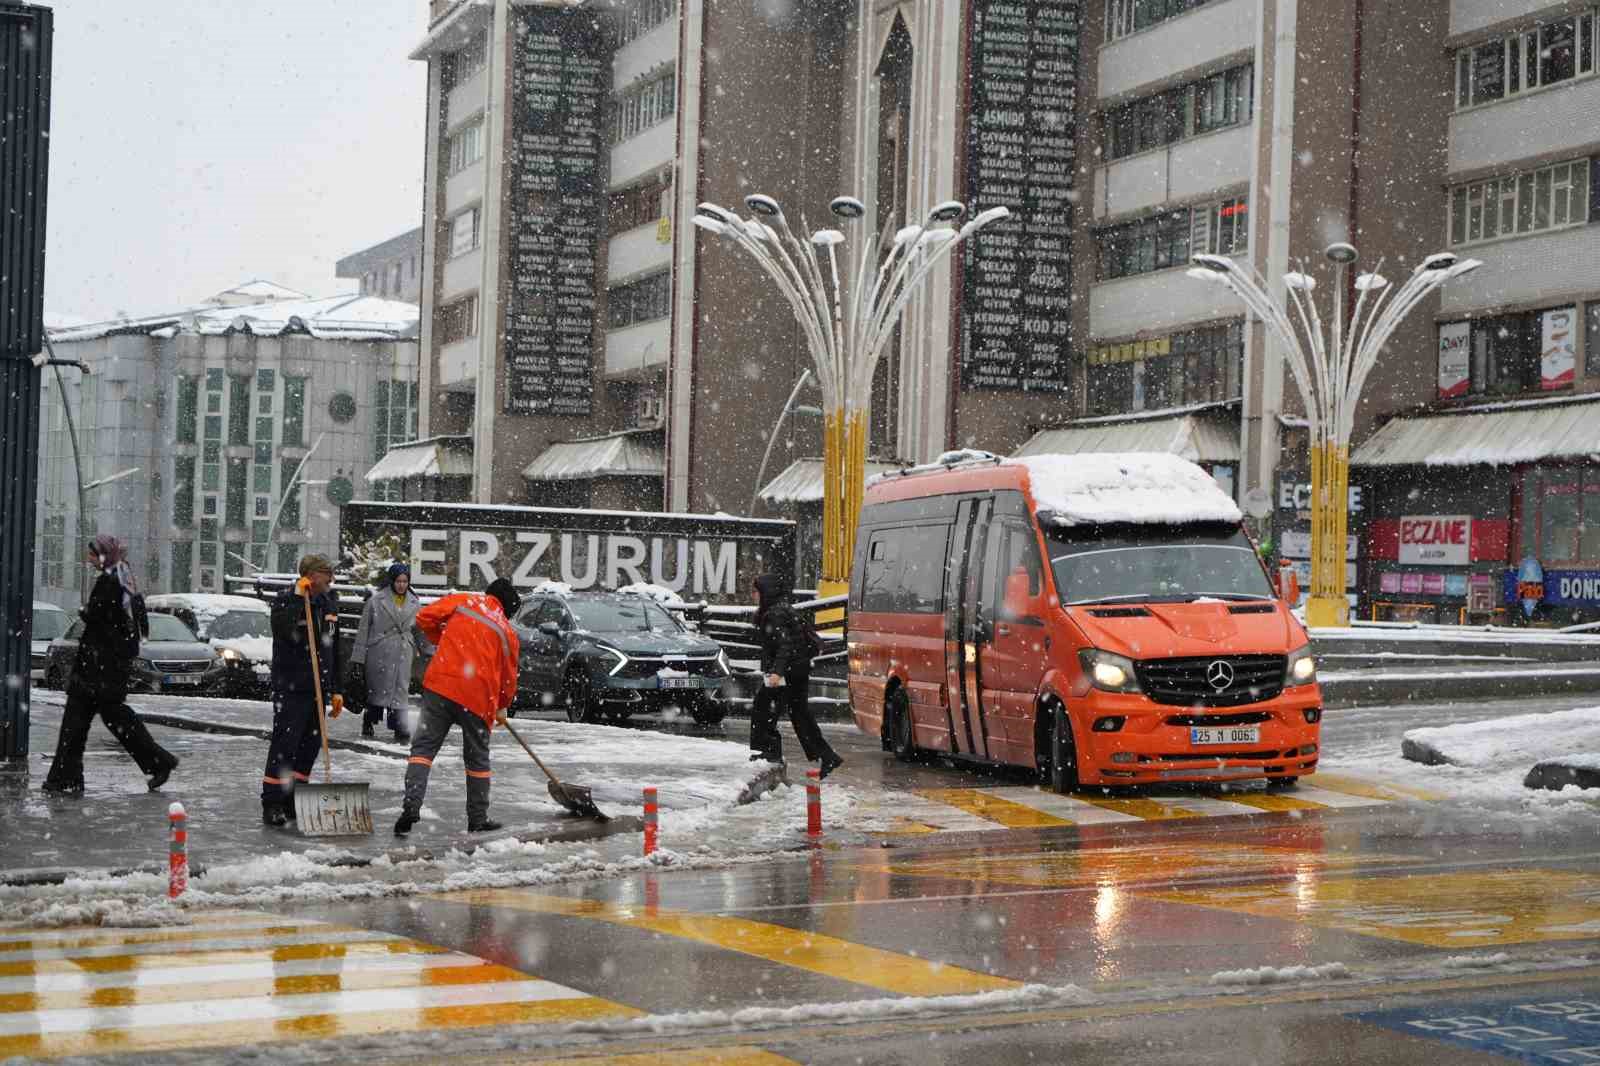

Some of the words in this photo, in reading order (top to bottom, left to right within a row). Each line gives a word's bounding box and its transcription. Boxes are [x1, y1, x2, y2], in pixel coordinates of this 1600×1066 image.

[988, 5, 1027, 17] AVUKAT
[1037, 8, 1076, 21] AVUKAT
[1024, 318, 1050, 334] KOD
[1051, 319, 1068, 335] 25
[1402, 521, 1466, 545] ECZANE
[410, 529, 737, 594] ERZURUM
[1199, 730, 1210, 742] 25
